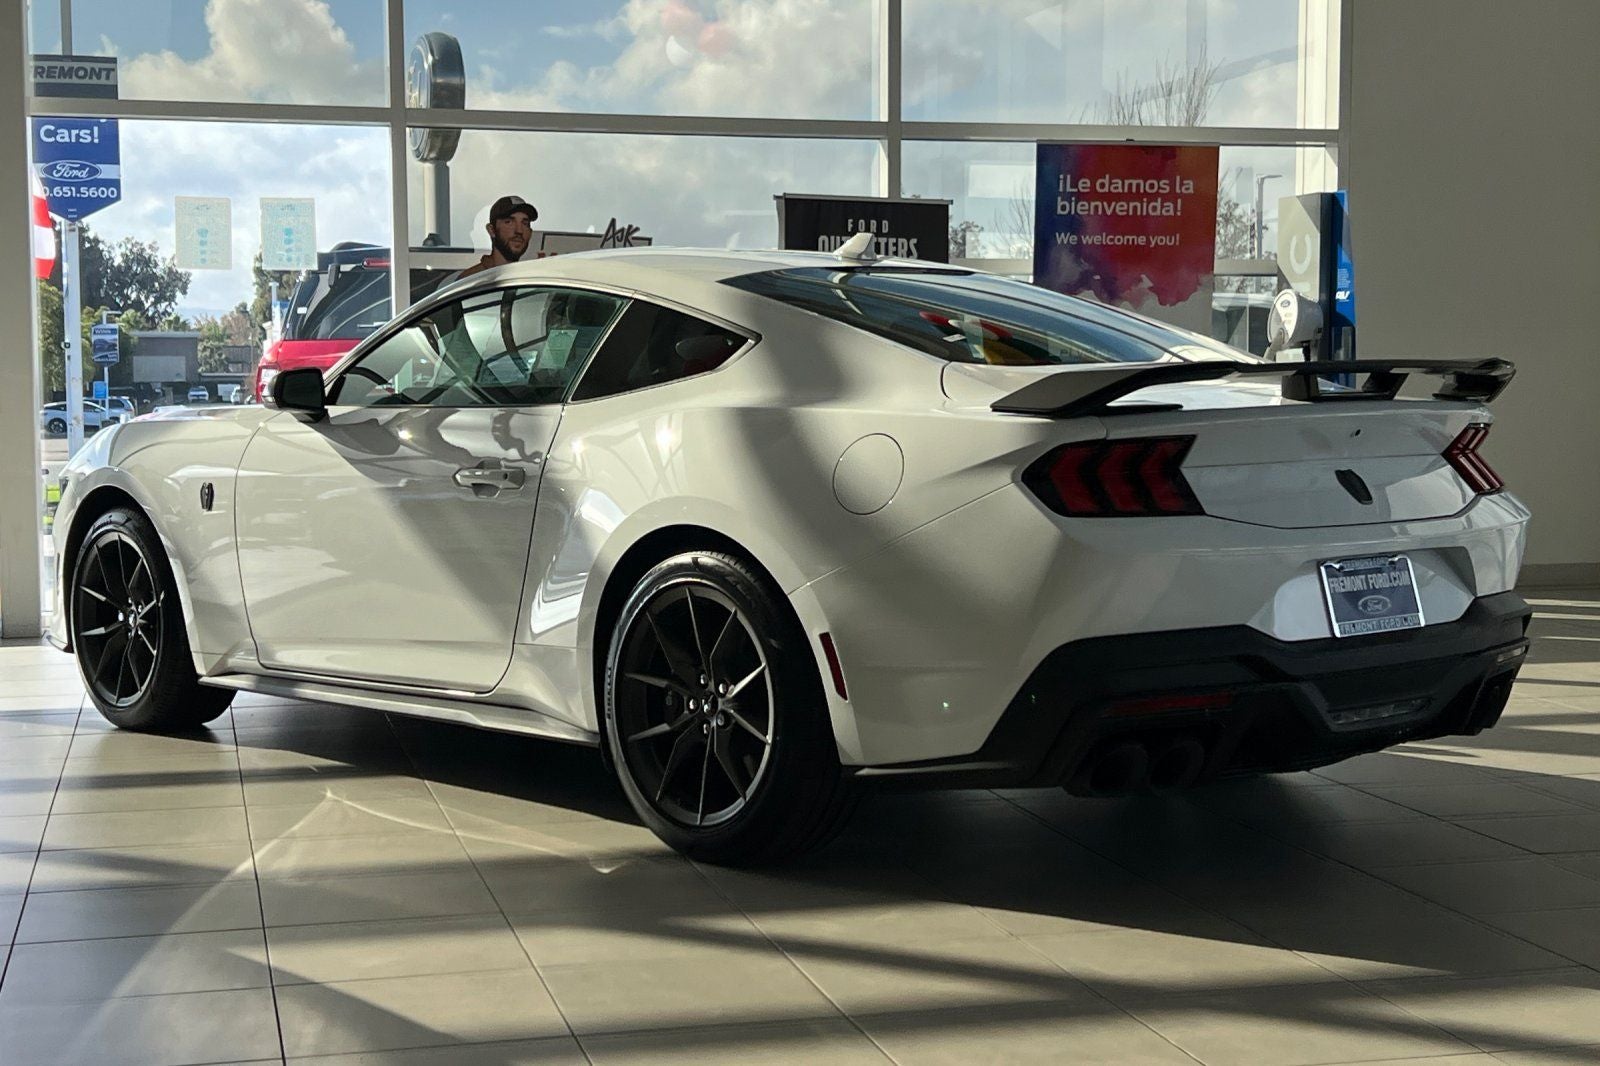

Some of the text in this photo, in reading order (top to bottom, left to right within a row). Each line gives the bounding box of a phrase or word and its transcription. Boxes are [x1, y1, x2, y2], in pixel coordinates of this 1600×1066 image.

[40, 125, 99, 143] Cars!
[52, 162, 90, 178] Ford
[1095, 174, 1170, 194] damos
[1175, 175, 1194, 194] la
[1056, 197, 1182, 216] bienvenida!
[847, 219, 889, 233] FORD
[817, 235, 918, 259] OUTERS
[1056, 232, 1180, 248] We welcome you!
[1328, 571, 1411, 593] FREMONT FORD.COM
